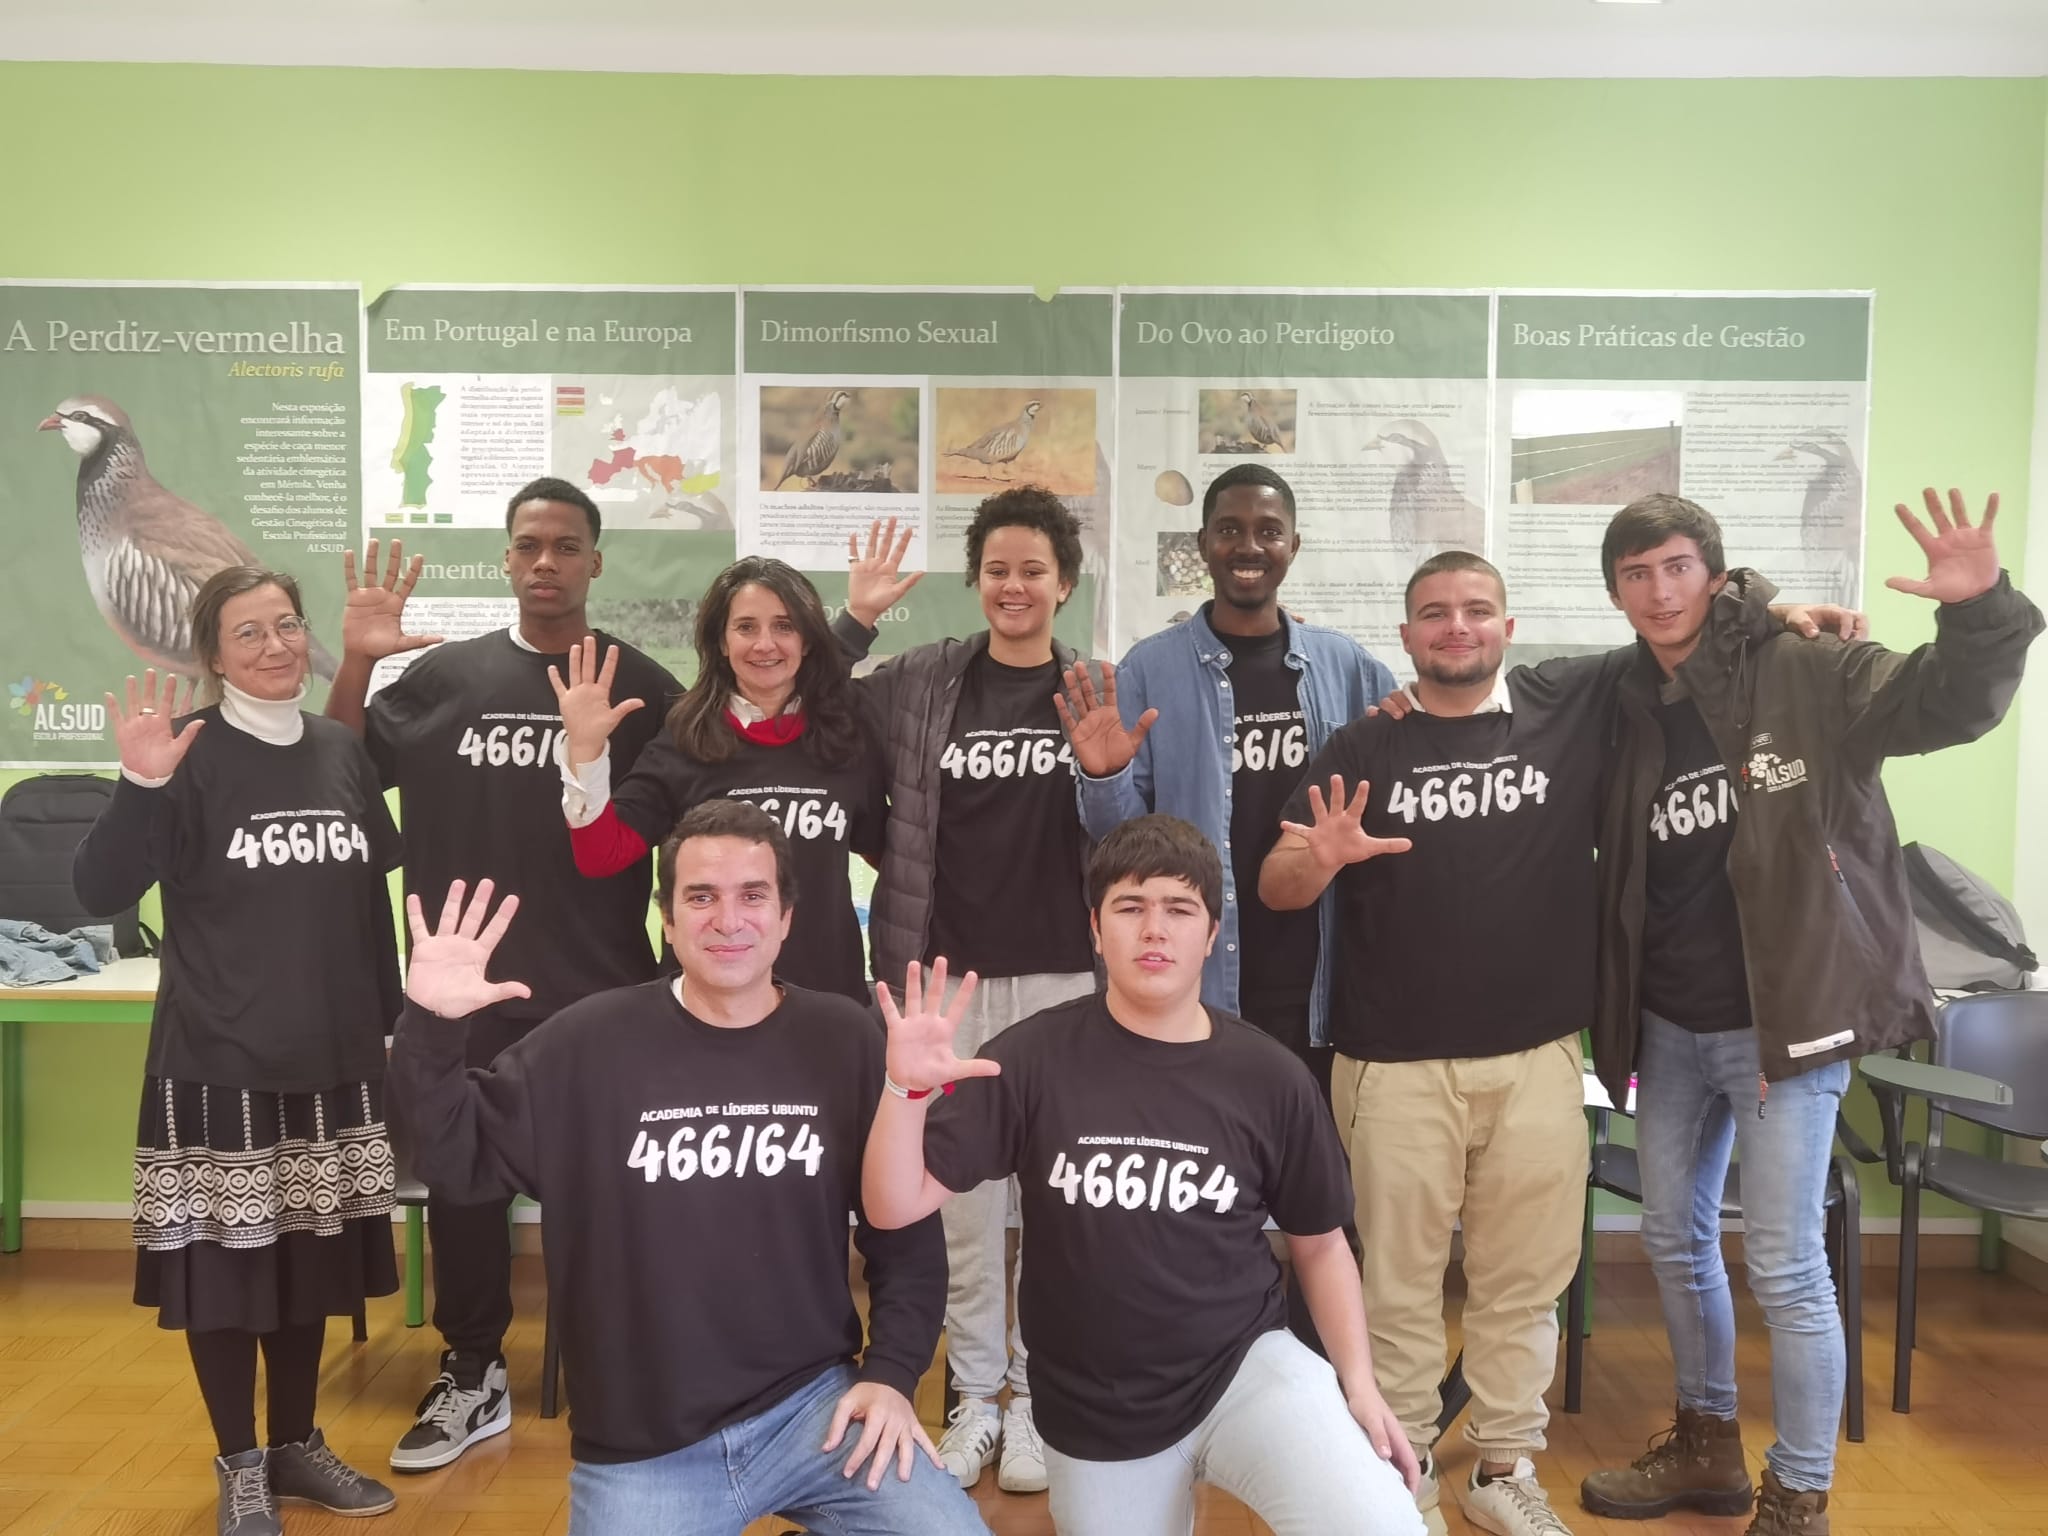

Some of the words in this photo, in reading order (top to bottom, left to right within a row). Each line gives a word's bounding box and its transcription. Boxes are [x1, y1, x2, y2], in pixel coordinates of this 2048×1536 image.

[4, 320, 37, 352] A
[46, 320, 345, 354] Perdiz-vermelha
[385, 318, 426, 342] Em
[434, 319, 539, 348] Portugal
[546, 325, 559, 343] e
[567, 325, 597, 343] na
[604, 320, 692, 349] Europa
[760, 319, 911, 344] Dimorfismo
[917, 320, 998, 345] Sexual
[1137, 322, 1173, 345] Do
[1181, 322, 1232, 345] Ovo
[1238, 328, 1268, 345] ao
[1275, 322, 1395, 351] Perdigoto
[1513, 323, 1571, 347] Boas
[1578, 324, 1676, 348] Práticas
[1683, 324, 1713, 348] de
[1720, 325, 1805, 349] Gestão
[228, 362, 303, 378] Alectoris
[308, 361, 345, 380] rufa
[272, 402, 298, 412] Nesta
[299, 403, 346, 414] exposição
[292, 415, 346, 426] informação
[312, 428, 338, 437] sobre
[244, 441, 278, 452] espécie
[279, 441, 291, 450] de
[292, 443, 312, 452] caça
[242, 466, 255, 475] da
[316, 480, 347, 489] Venha
[250, 505, 284, 514] desafio
[334, 505, 347, 514] de
[251, 517, 284, 527] Gestão
[286, 518, 333, 530] Cinegética
[334, 518, 347, 527] da
[262, 531, 292, 540] Escola
[294, 531, 347, 540] Profissional
[307, 543, 344, 553] ALSUD
[34, 703, 105, 731] ALSUD
[1255, 711, 1291, 722] LÍDERES
[940, 738, 1077, 780] 466/64
[1766, 758, 1806, 787] ALSUD
[1387, 765, 1550, 823] 466/64
[226, 820, 369, 868] 466/64
[640, 1107, 703, 1123] ACADEMIA
[705, 1105, 719, 1115] DE
[722, 1102, 769, 1116] LÍDERES
[772, 1104, 819, 1116] UBUNTU
[627, 1122, 825, 1183] 466/64
[1077, 1136, 1122, 1145] ACADEMIA
[1123, 1136, 1136, 1145] DE
[1137, 1135, 1172, 1149] LÍDERES
[1172, 1141, 1209, 1155] UBUNTU
[1048, 1152, 1239, 1214] 466/64
